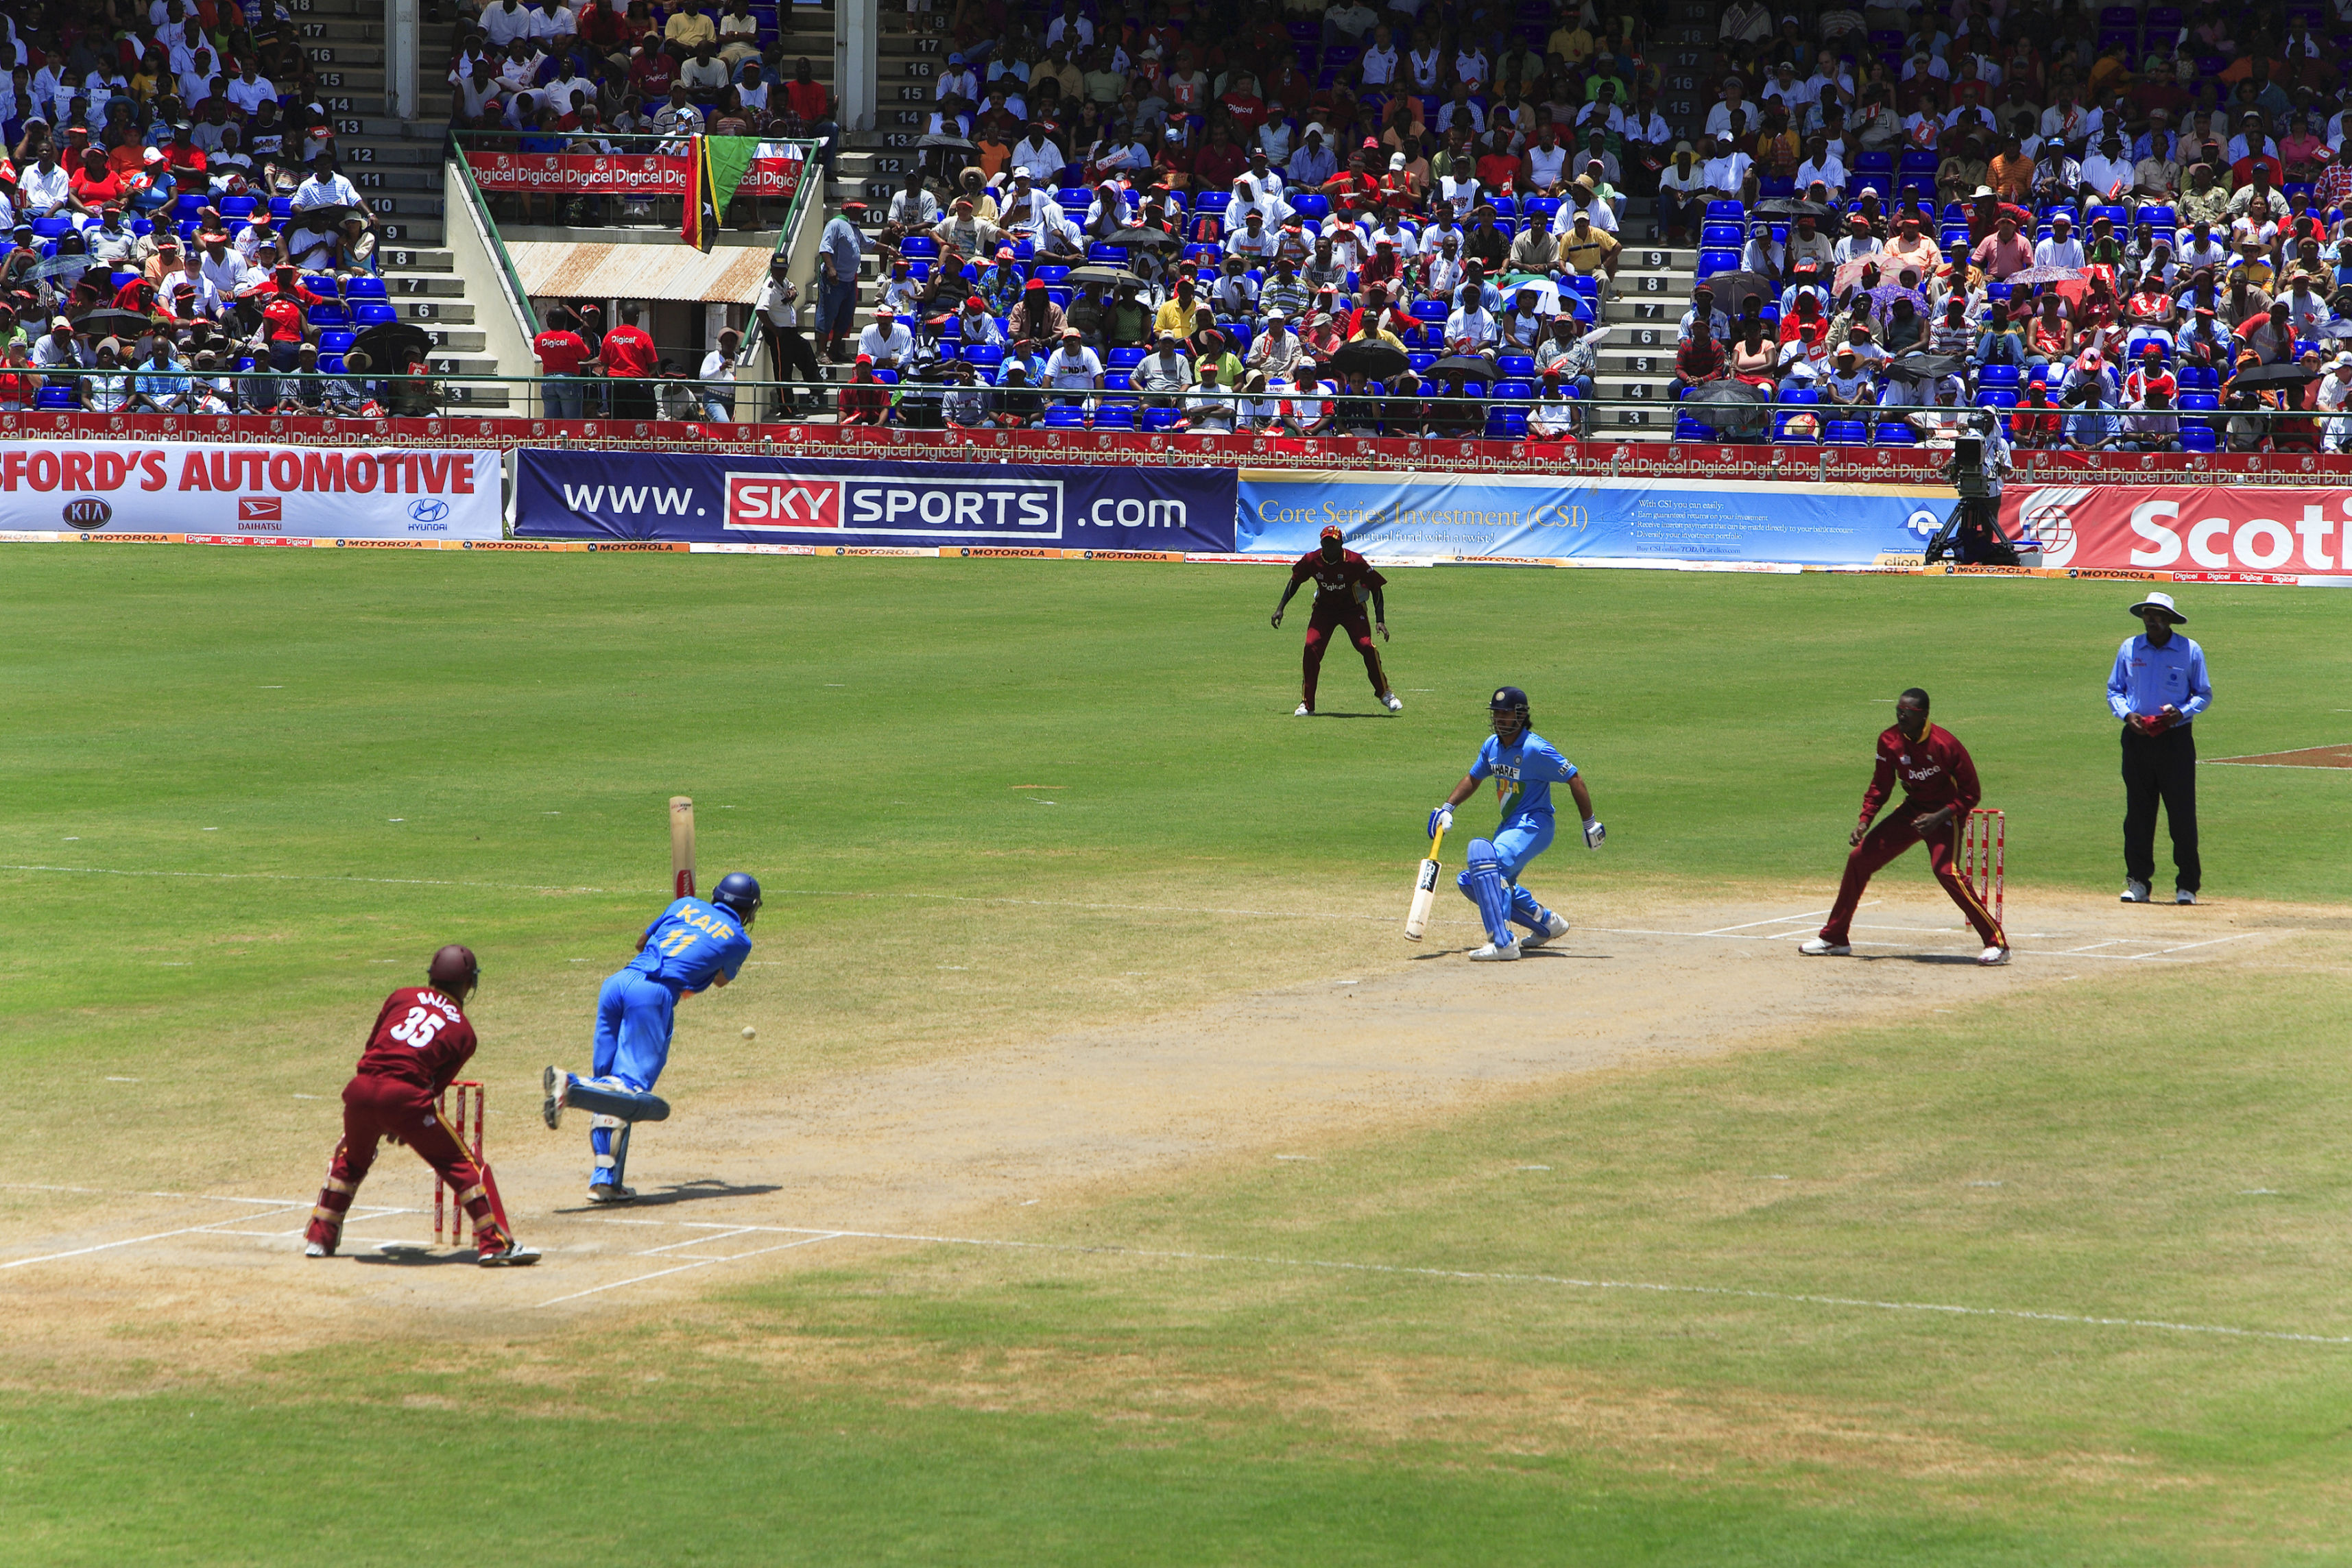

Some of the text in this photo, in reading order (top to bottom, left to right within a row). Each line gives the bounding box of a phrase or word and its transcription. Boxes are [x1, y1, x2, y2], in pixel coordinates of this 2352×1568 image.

[291, 0, 309, 10] 18
[304, 25, 323, 36] 17
[1681, 30, 1701, 42] 18
[919, 40, 938, 51] 17
[311, 50, 331, 61] 16
[1679, 53, 1698, 66] 17
[909, 63, 928, 75] 16
[1147, 67, 1154, 78] 4
[320, 74, 339, 85] 15
[1673, 77, 1692, 89] 16
[902, 88, 922, 99] 15
[1181, 88, 1189, 101] 4
[328, 99, 348, 110] 14
[1227, 104, 1253, 114] Digicel
[1670, 102, 1690, 114] 15
[898, 112, 919, 123] 14
[339, 121, 358, 132] 13
[1919, 128, 1929, 140] 4
[887, 134, 907, 147] 13
[351, 149, 372, 160] 12
[1107, 151, 1127, 165] Digicel
[879, 159, 900, 171] 12
[361, 174, 380, 185] 11
[470, 167, 515, 184] Digicel
[518, 167, 563, 185] Digicel
[567, 169, 612, 186] Digicel
[616, 169, 662, 186] Digicel
[872, 185, 891, 197] 11
[372, 199, 392, 211] 10
[863, 210, 883, 223] 10
[387, 226, 397, 239] 9
[396, 252, 407, 265] 8
[1651, 252, 1661, 265] 9
[408, 280, 418, 292] 7
[1647, 278, 1658, 291] 8
[418, 304, 429, 317] 6
[1645, 305, 1655, 317] 7
[429, 333, 438, 345] 5
[612, 335, 637, 343] Digicel
[1642, 330, 1651, 343] 6
[542, 339, 569, 348] Digicel
[440, 361, 450, 372] 4
[1637, 358, 1647, 370] 5
[452, 388, 462, 400] 3
[1631, 385, 1643, 398] 4
[1629, 411, 1639, 424] 3
[293, 432, 341, 444] Digicel
[451, 434, 499, 448] Digicel
[607, 435, 654, 452] Digicel
[709, 437, 755, 453] Digicel
[863, 441, 911, 459] Digicel
[1018, 445, 1066, 462] Digicel
[1070, 446, 1117, 463] Digicel
[1121, 447, 1167, 465] Digicel
[1276, 450, 1323, 469] Digicel
[1430, 454, 1479, 472] Digicel
[1639, 459, 1687, 477] Digicel
[1690, 459, 1739, 477] Digicel
[1847, 463, 1896, 480] Digicel
[2058, 468, 2106, 482] Digicel
[2110, 468, 2159, 483] Digicel
[0, 450, 475, 494] FORD'S AUTOMOTIVE
[739, 486, 832, 520] SKY
[853, 489, 1049, 525] SPORTS
[1078, 498, 1187, 528] .com
[1639, 500, 1656, 508] With
[1703, 501, 1724, 511] easily:
[71, 503, 104, 521] KIA
[1258, 500, 1588, 532] Core Series Investment (CSI)
[1685, 522, 1714, 531] payments
[1766, 524, 1788, 533] directly
[189, 535, 211, 543] Digicel
[1352, 531, 1393, 542] mutual
[1395, 531, 1421, 542] fund
[1422, 531, 1444, 542] with
[1462, 533, 1495, 543] twist!
[475, 542, 549, 550] MOTOROLA
[973, 548, 1045, 557] MOTOROLA
[2080, 570, 2155, 580] MOTOROLA
[1492, 764, 1514, 778] AHARA
[1909, 765, 1941, 780] Digice
[676, 904, 734, 939] KAIF
[660, 928, 699, 957] 11
[417, 991, 461, 1024] BAUGH
[390, 1006, 446, 1048] 35
